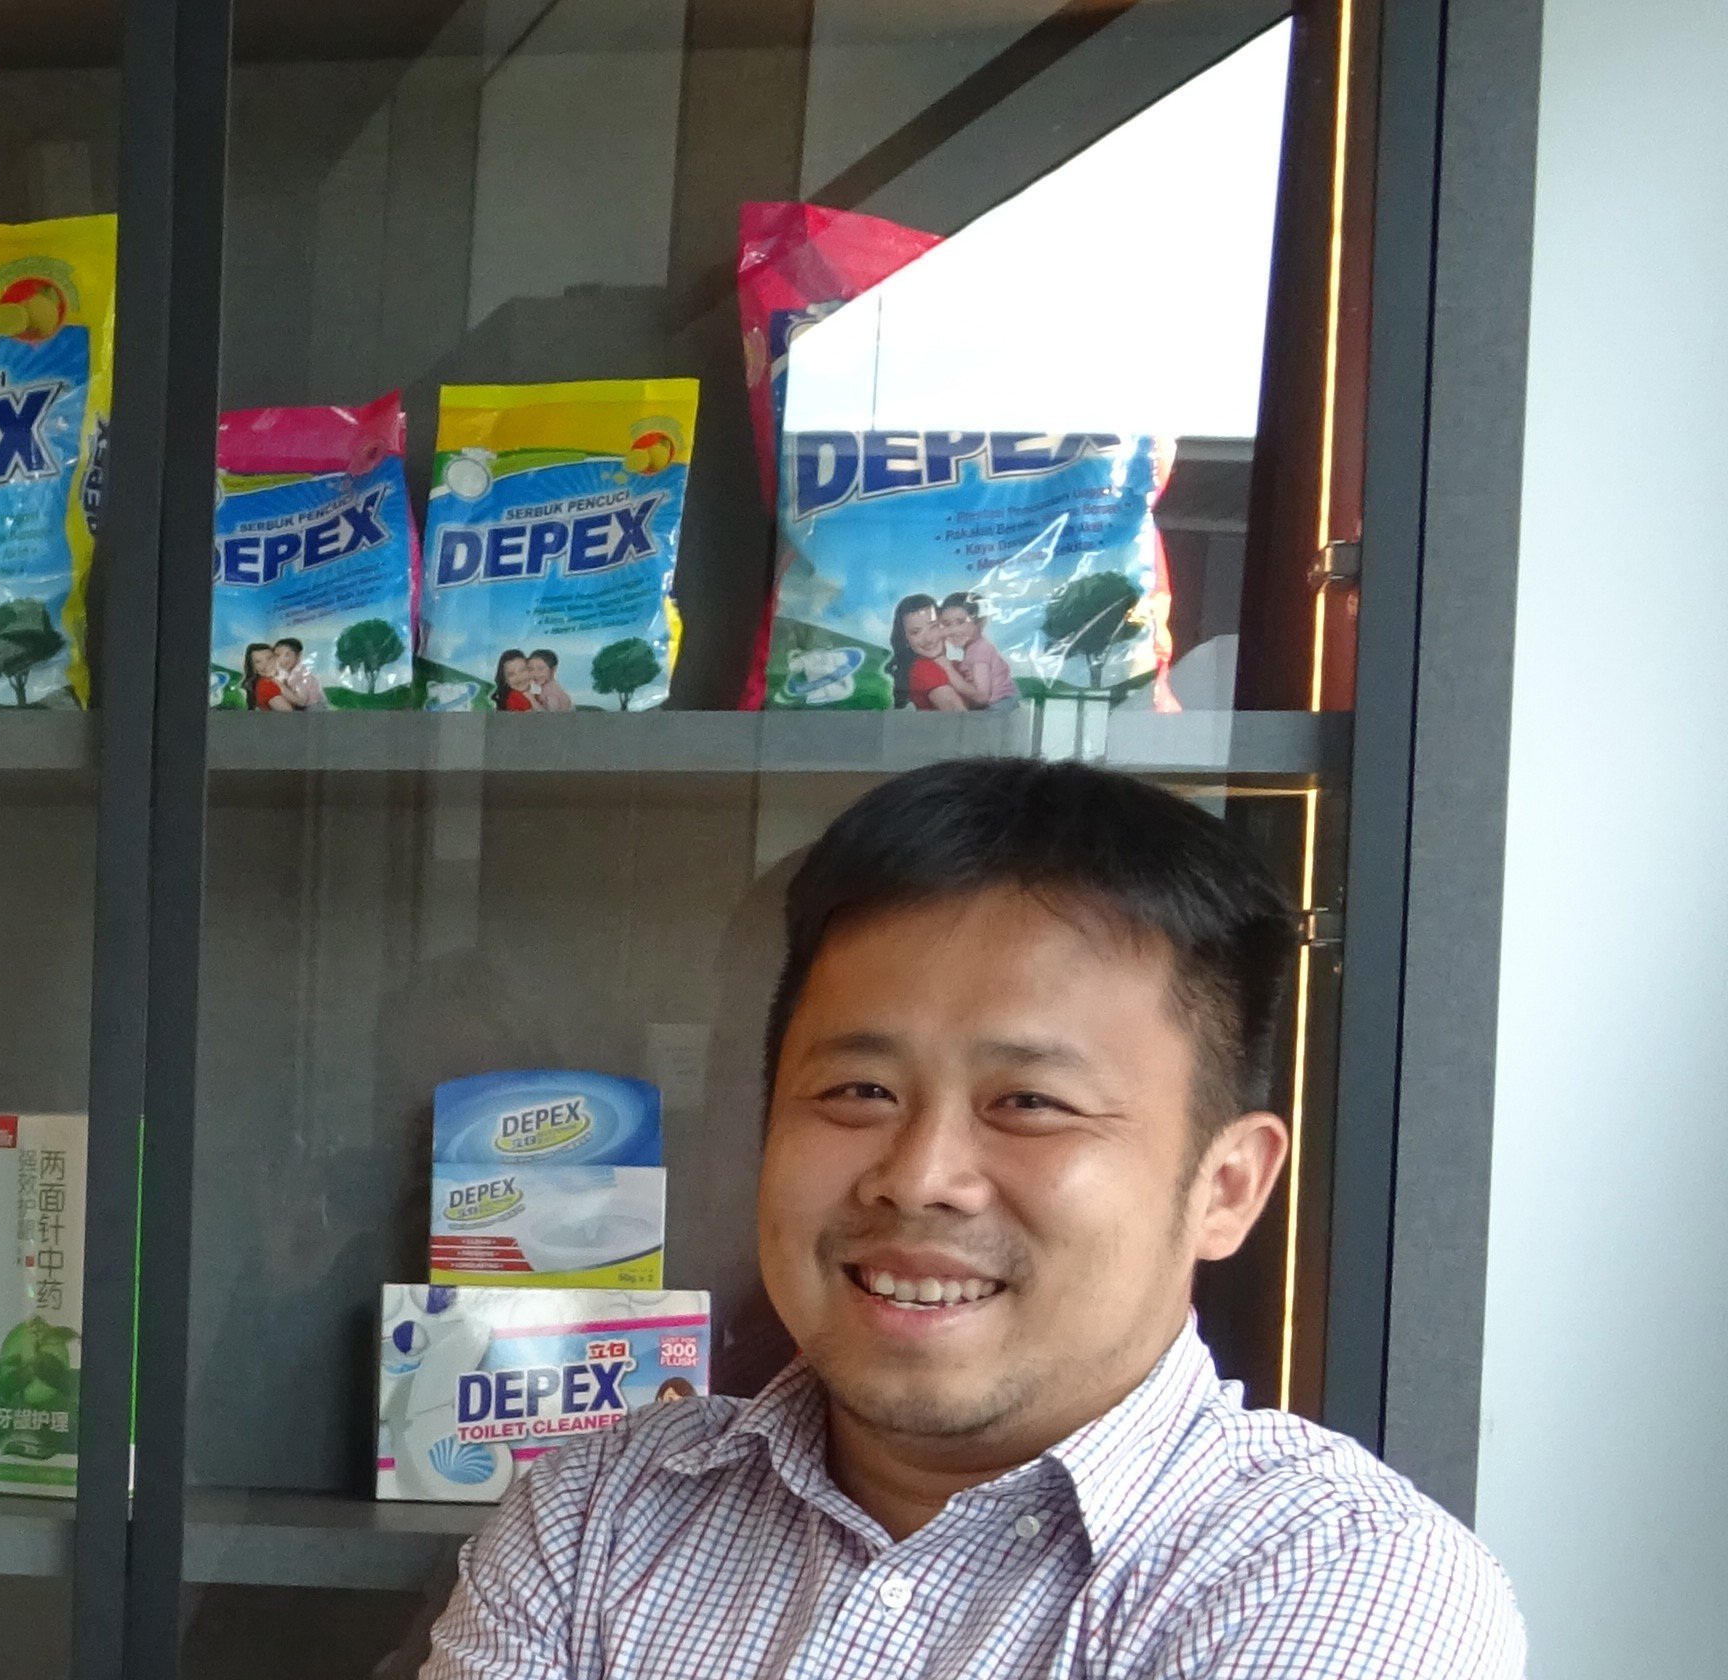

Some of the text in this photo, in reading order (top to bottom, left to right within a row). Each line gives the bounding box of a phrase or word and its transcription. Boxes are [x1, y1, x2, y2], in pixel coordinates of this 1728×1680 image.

[506, 491, 630, 521] SERBUK PENCUCI
[213, 489, 389, 584] EPEX
[239, 517, 294, 534] SERBUK
[437, 498, 657, 585] DEPEX
[501, 1101, 582, 1138] DEPEX
[449, 1177, 516, 1209] DEPEX
[36, 1150, 67, 1312] 两面针中药
[589, 1342, 627, 1359] 立白
[660, 1343, 698, 1358] 300
[458, 1362, 625, 1424] DEPEX
[457, 1422, 526, 1442] TOILET
